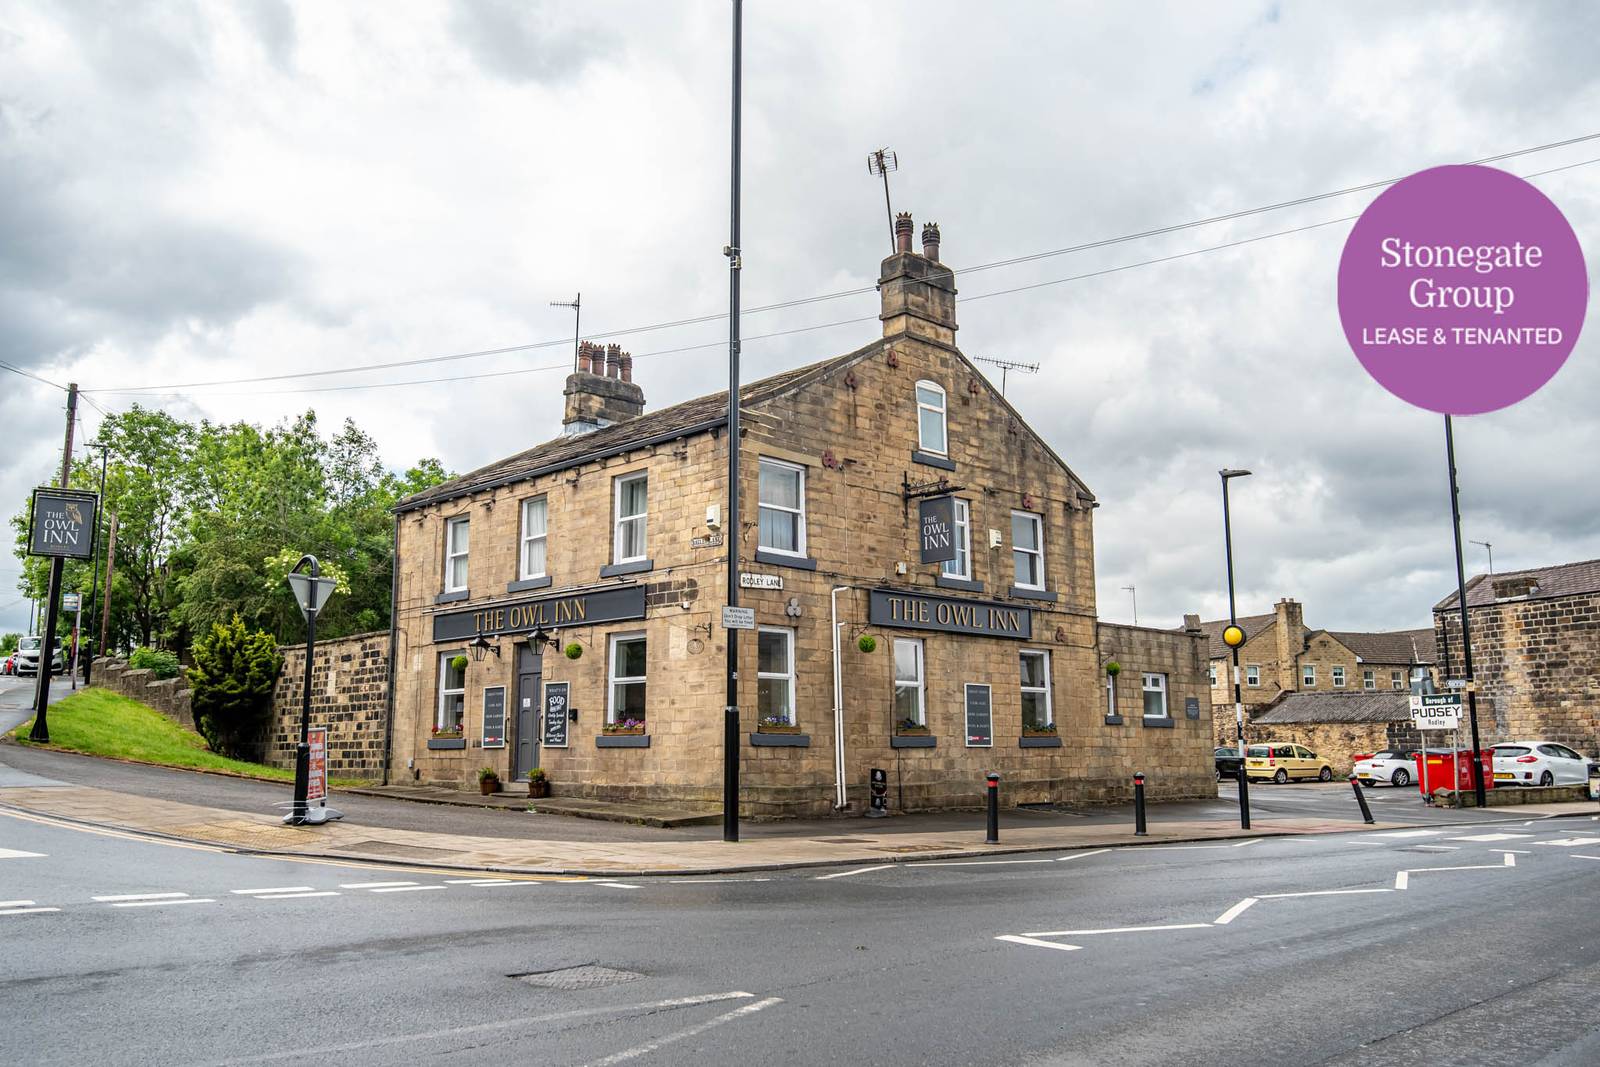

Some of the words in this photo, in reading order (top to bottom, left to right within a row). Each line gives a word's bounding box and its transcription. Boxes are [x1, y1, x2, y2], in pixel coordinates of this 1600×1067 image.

[46, 511, 65, 519] THE
[924, 515, 938, 524] THE
[44, 519, 80, 531] OWL
[923, 522, 950, 536] OWL
[43, 530, 79, 545] INN
[924, 533, 950, 550] INN
[742, 576, 764, 586] RODLEY
[766, 577, 781, 587] LANE
[473, 609, 506, 632] THE
[510, 603, 549, 629] OWL
[554, 598, 587, 623] INN
[888, 598, 930, 623] THE
[937, 602, 983, 628] OWL
[989, 608, 1021, 632] INN
[549, 695, 565, 706] FOOD
[1411, 706, 1460, 718] PUDSEY
